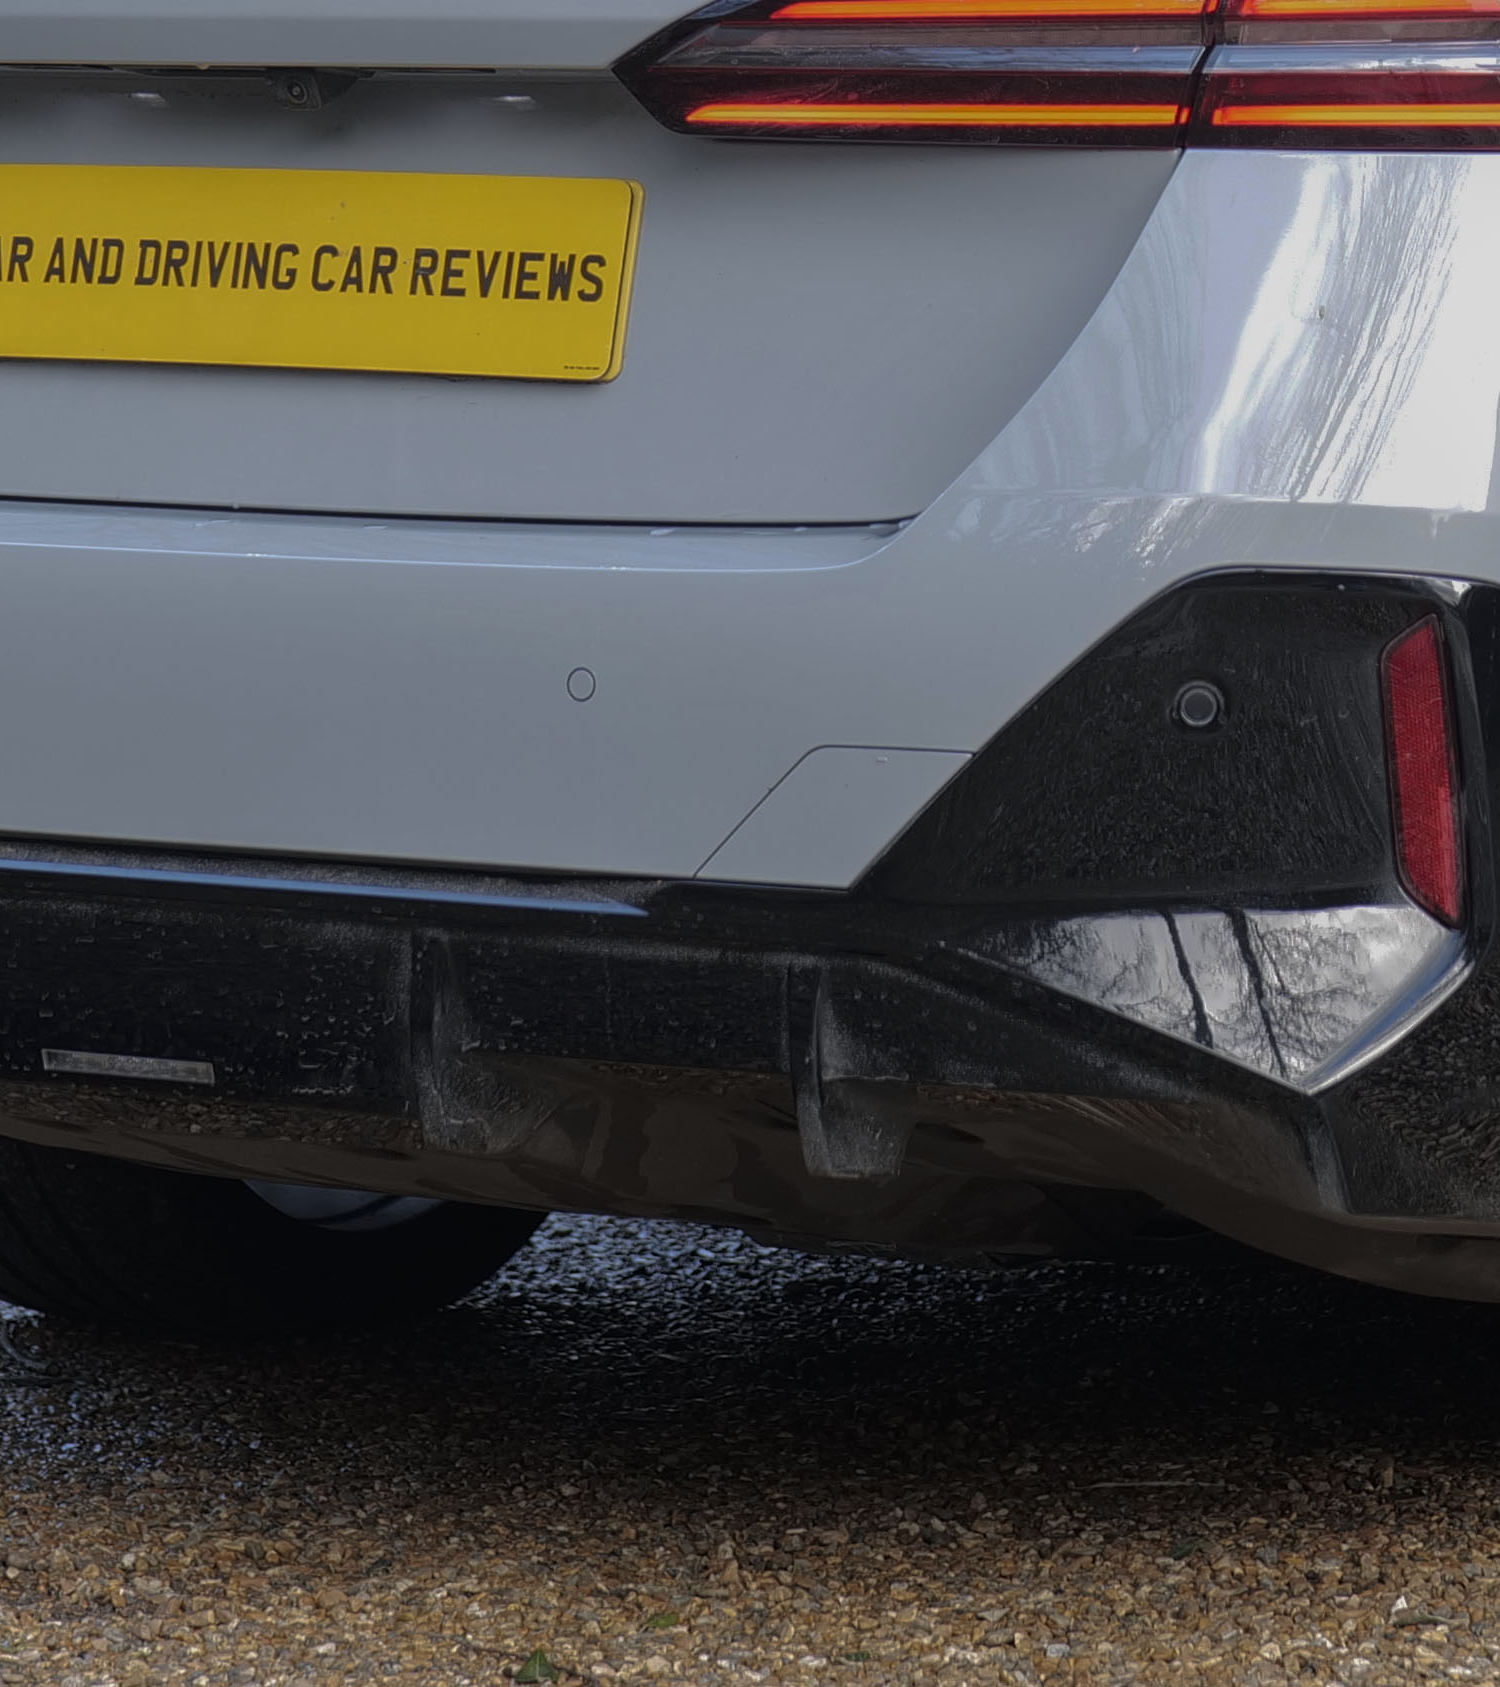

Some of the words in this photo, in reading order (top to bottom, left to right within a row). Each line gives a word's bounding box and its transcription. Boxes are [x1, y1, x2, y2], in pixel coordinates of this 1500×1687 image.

[43, 236, 125, 285] AND
[134, 239, 299, 290] DRIVING
[311, 244, 399, 295] CAR
[409, 247, 607, 302] REVIEWS
